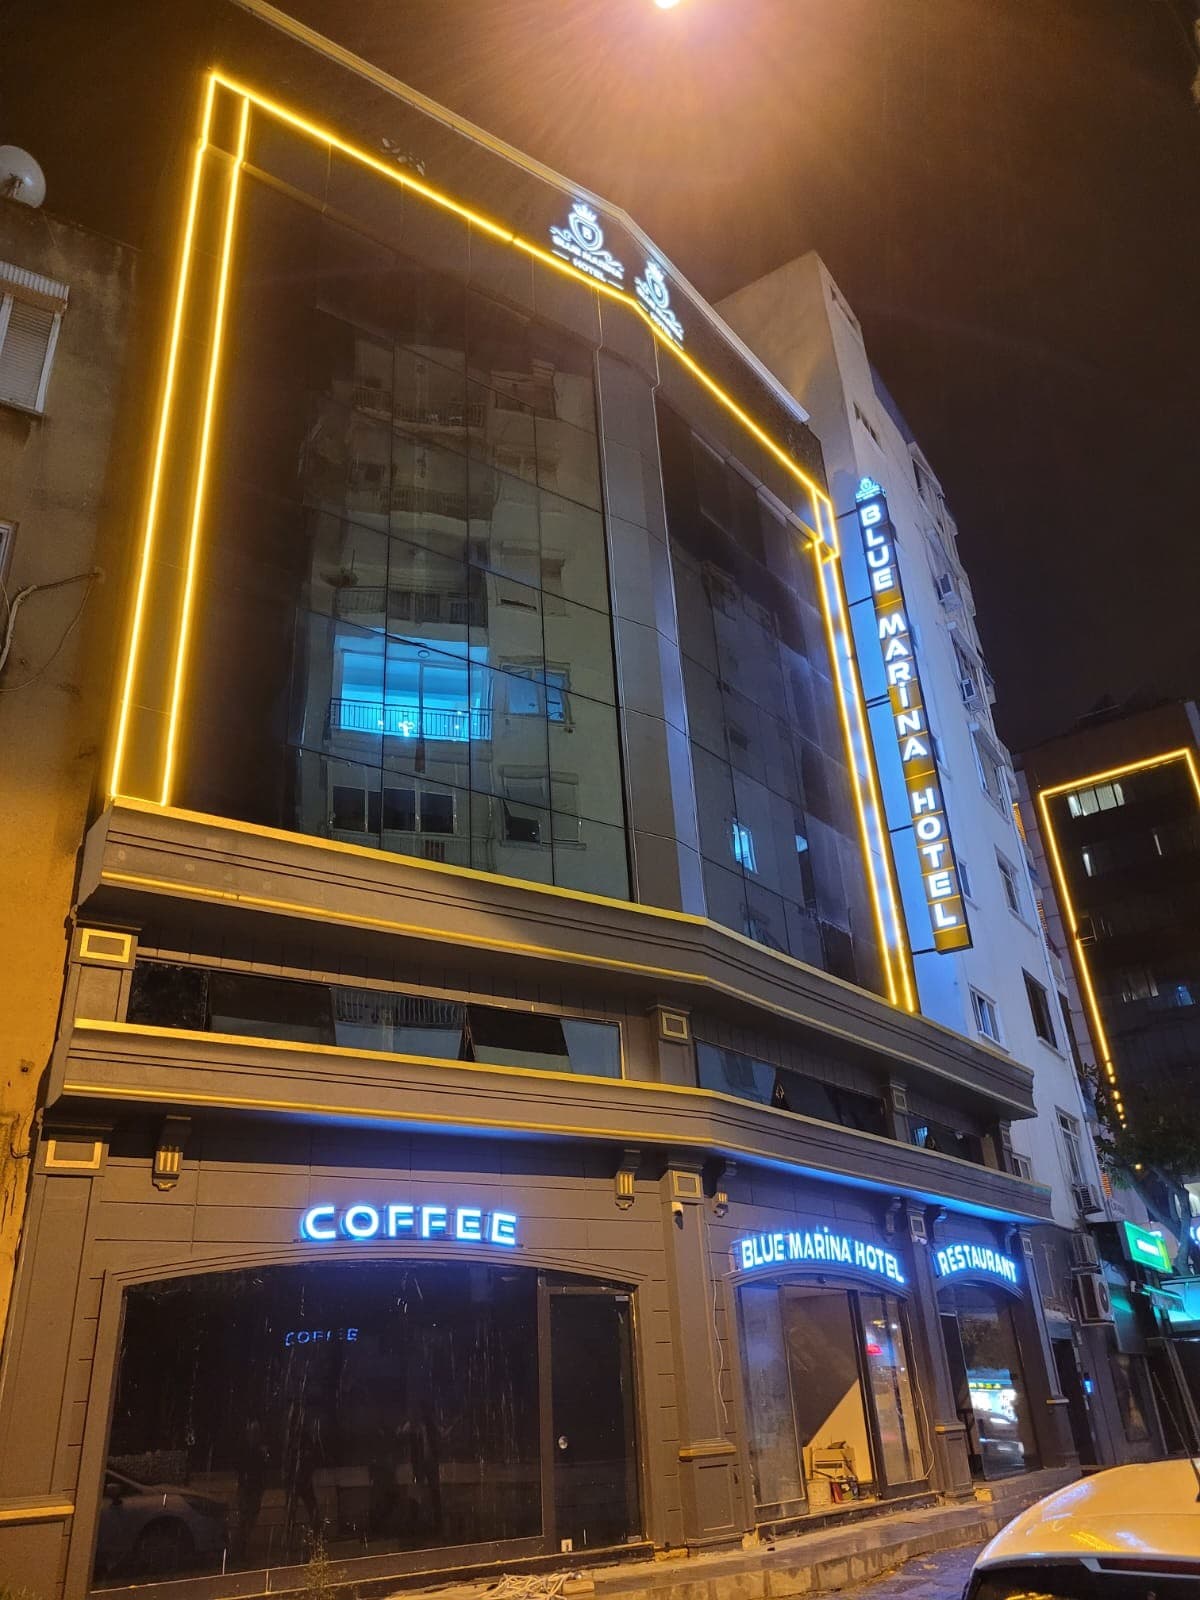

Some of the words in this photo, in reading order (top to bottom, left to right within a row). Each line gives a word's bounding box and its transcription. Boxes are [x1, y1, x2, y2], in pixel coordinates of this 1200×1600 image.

[860, 503, 893, 592] BLUE
[912, 787, 957, 928] HOTEL
[302, 1204, 517, 1246] COFFEE
[741, 1233, 785, 1269] BLUE
[854, 1241, 905, 1284] HOTEL
[937, 1244, 1017, 1283] RESTAURANT
